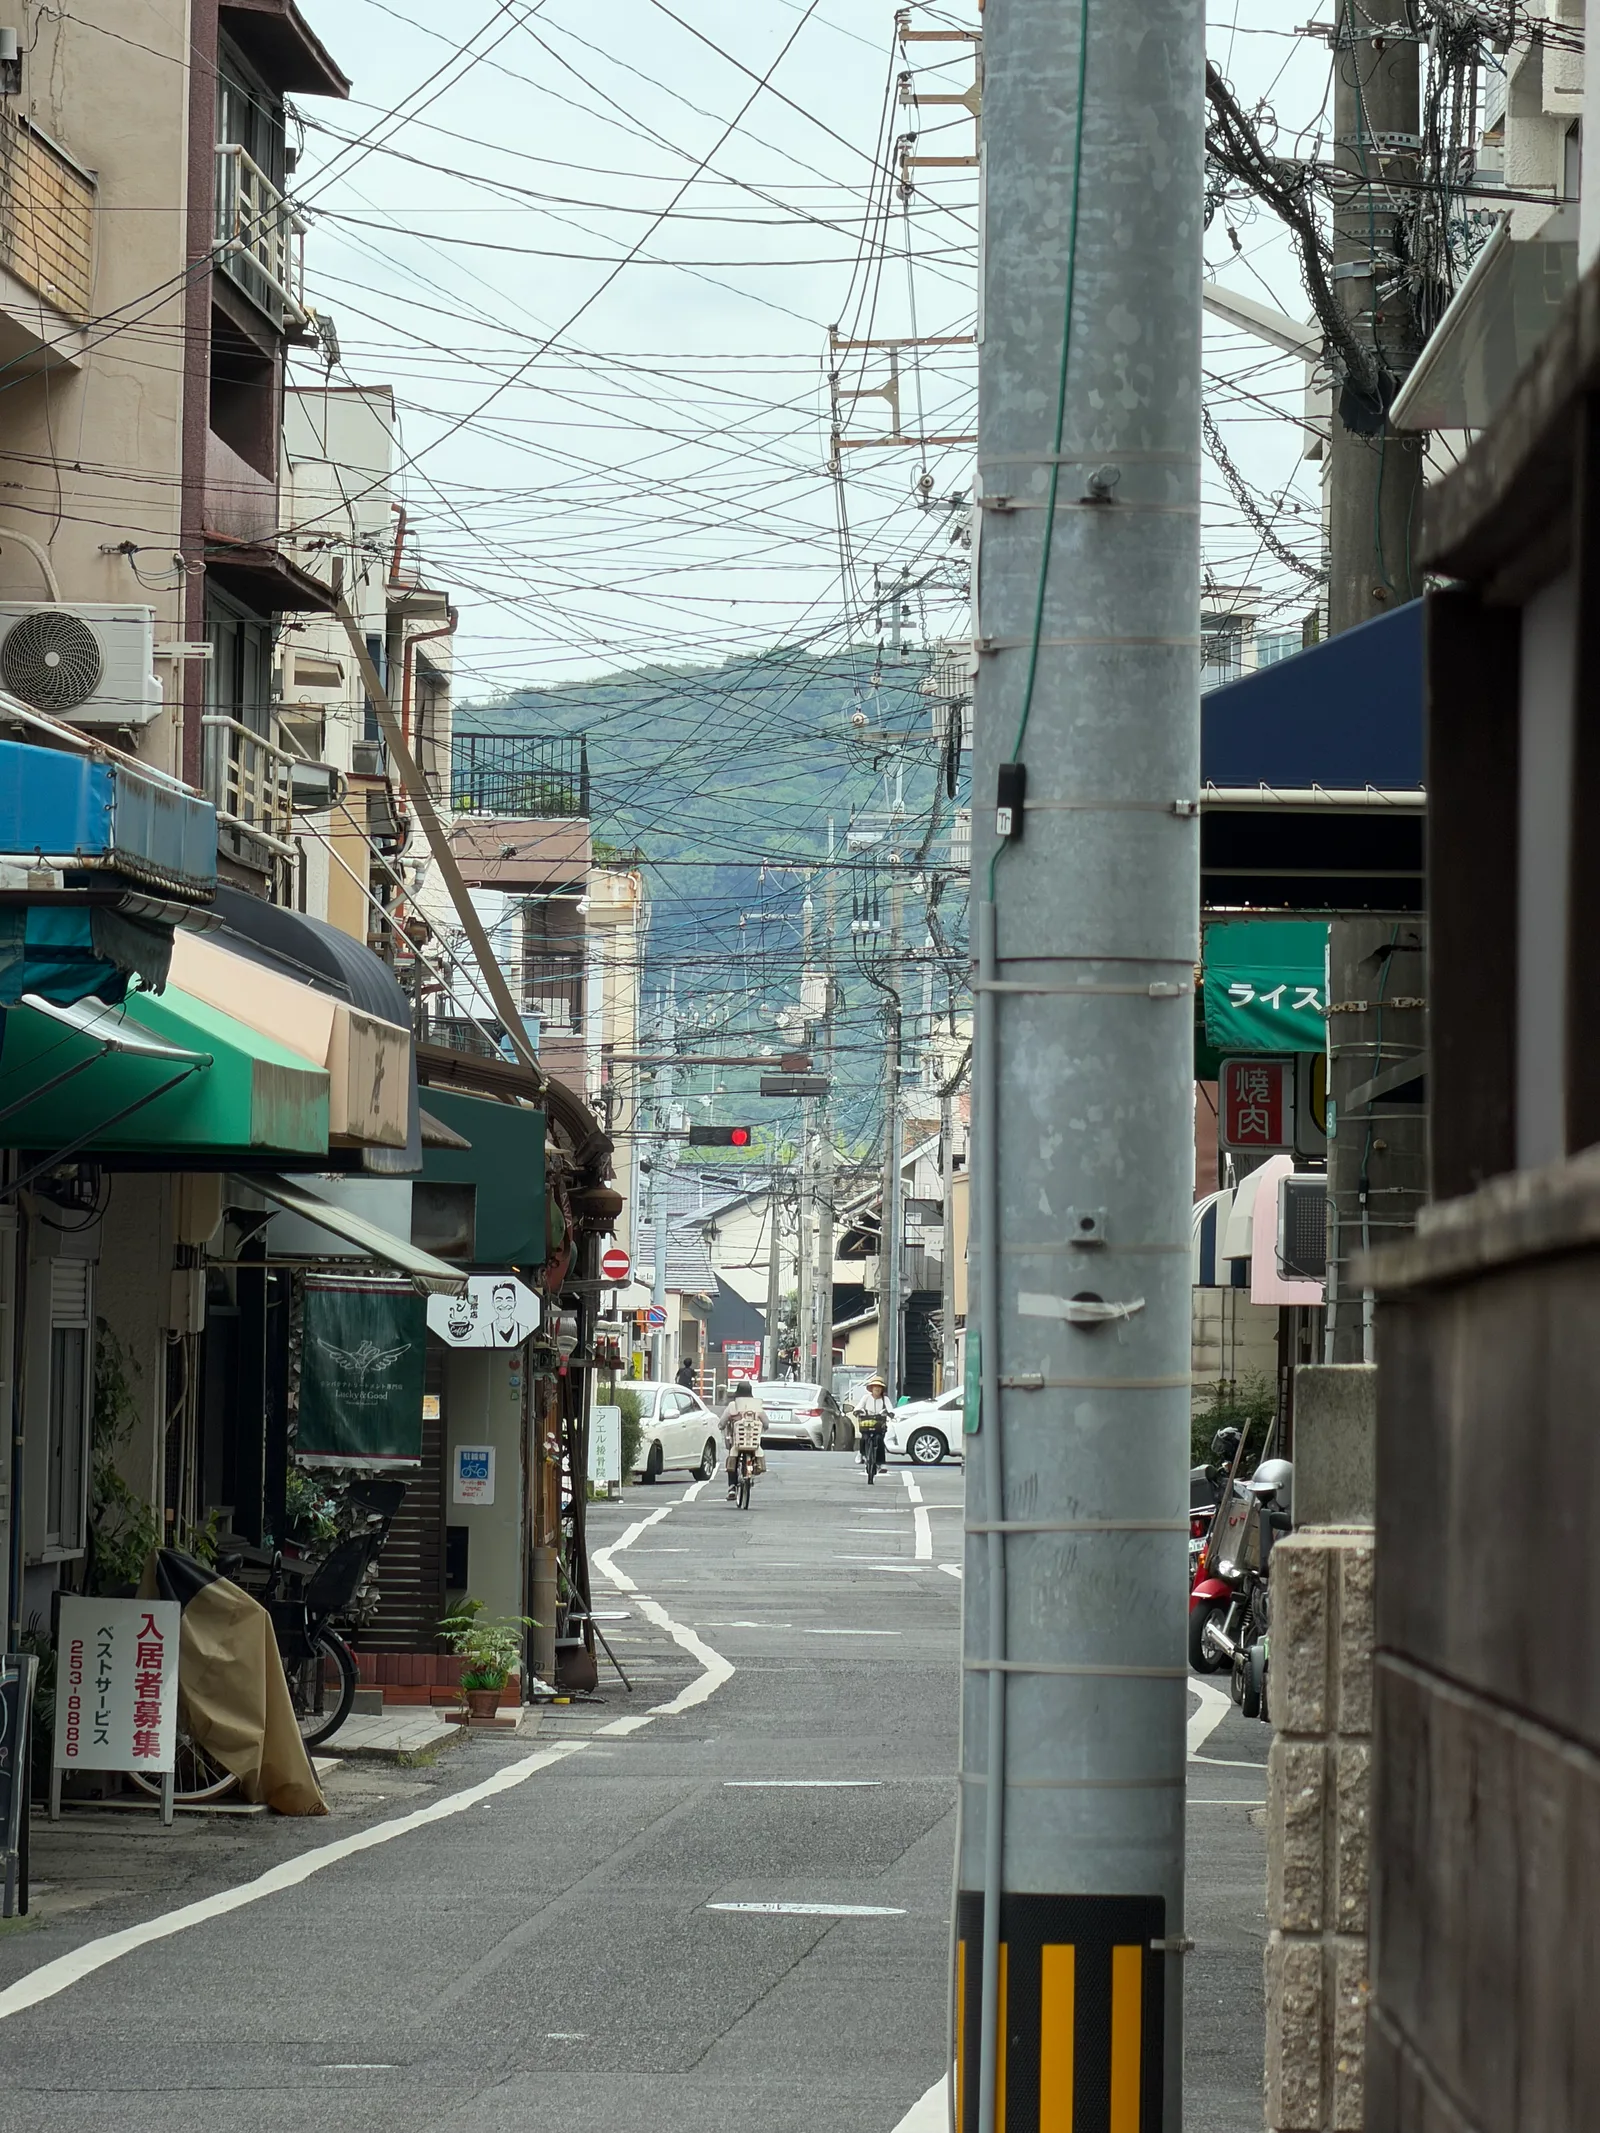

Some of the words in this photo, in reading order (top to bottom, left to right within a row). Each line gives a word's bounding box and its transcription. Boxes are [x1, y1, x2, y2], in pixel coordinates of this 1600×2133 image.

[1227, 983, 1323, 1010] ライス
[1236, 1066, 1271, 1140] 焼肉
[65, 1640, 84, 1757] 253-8886
[93, 1626, 114, 1745] ベストサービス
[132, 1614, 164, 1759] 入居者募集
